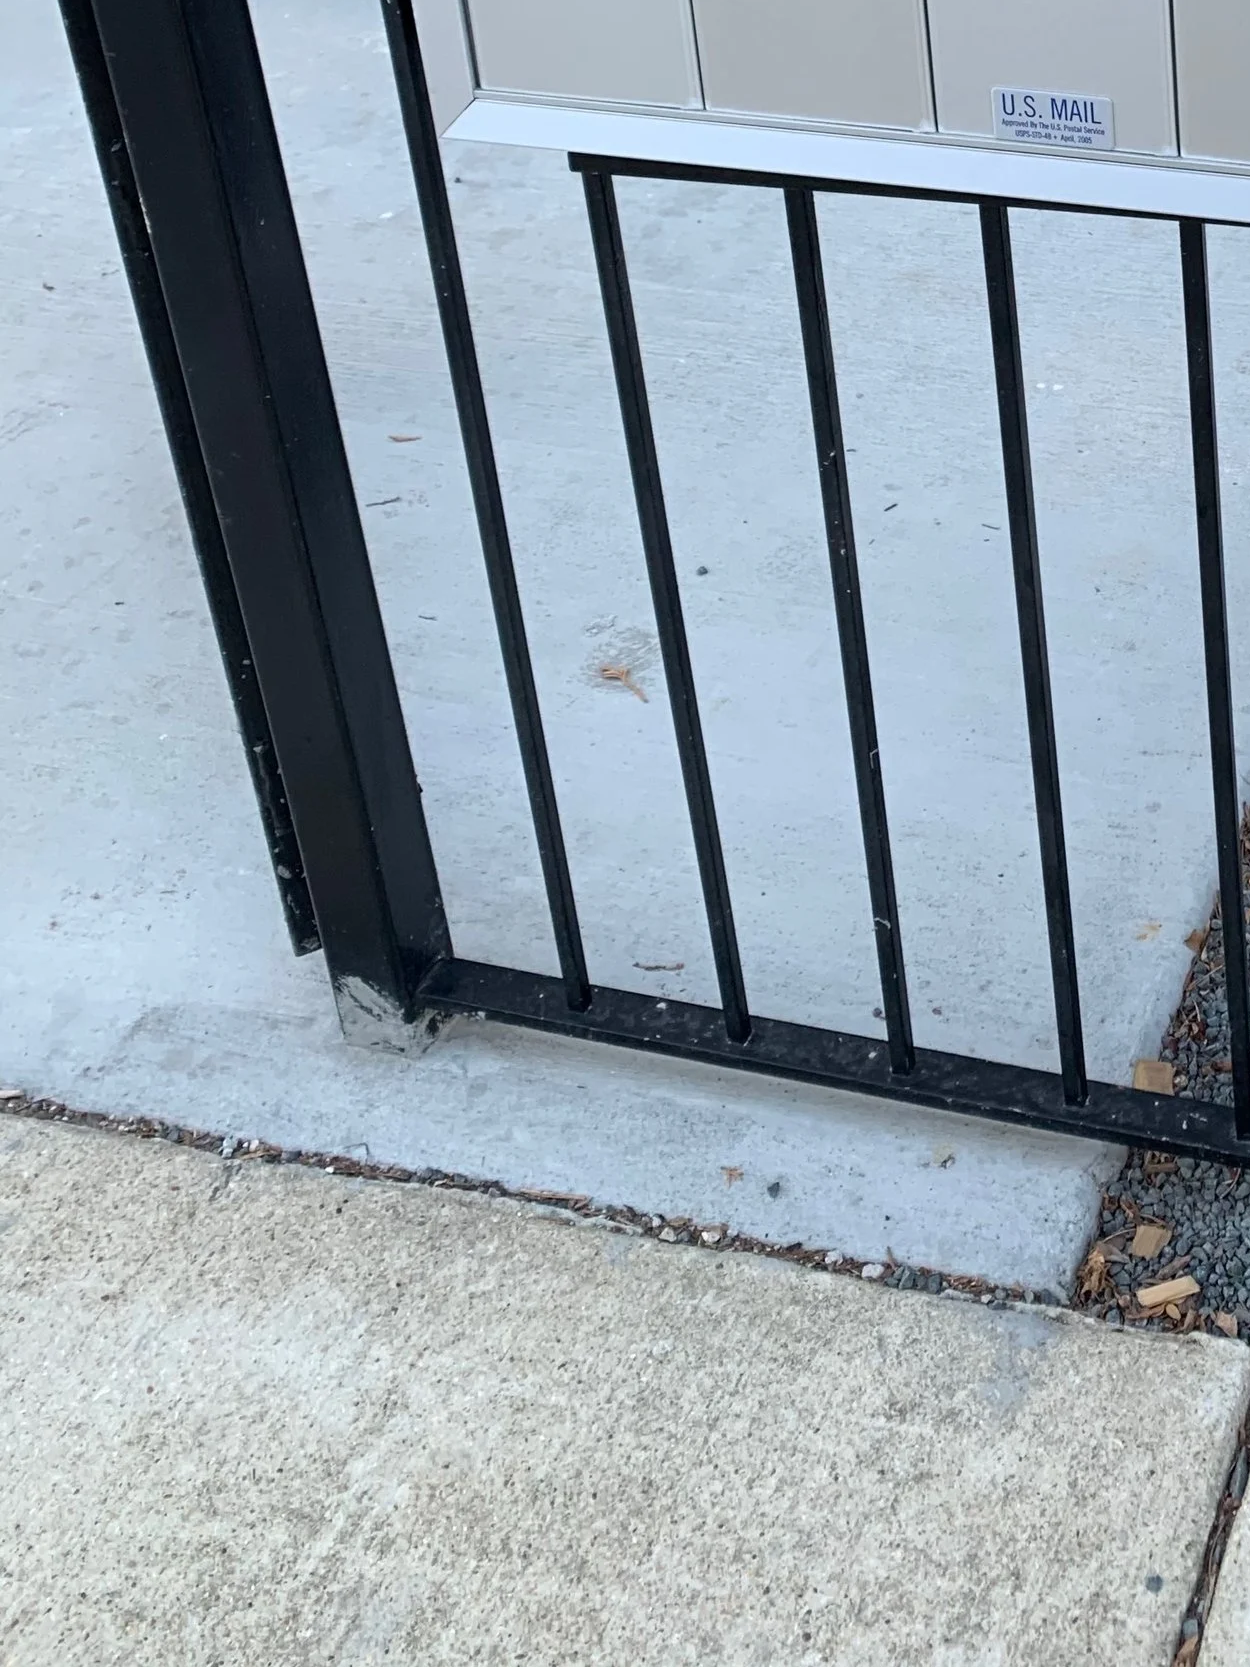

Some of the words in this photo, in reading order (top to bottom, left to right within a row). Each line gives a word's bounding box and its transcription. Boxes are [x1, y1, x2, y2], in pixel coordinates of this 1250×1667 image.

[1001, 92, 1043, 119] U.S.
[1050, 97, 1102, 125] MAIL
[1001, 118, 1029, 128] Approved
[1030, 120, 1038, 129] By
[1039, 121, 1050, 130] The
[1050, 123, 1062, 132] U.S.
[1063, 124, 1082, 133] Postal
[1083, 126, 1105, 136] Service
